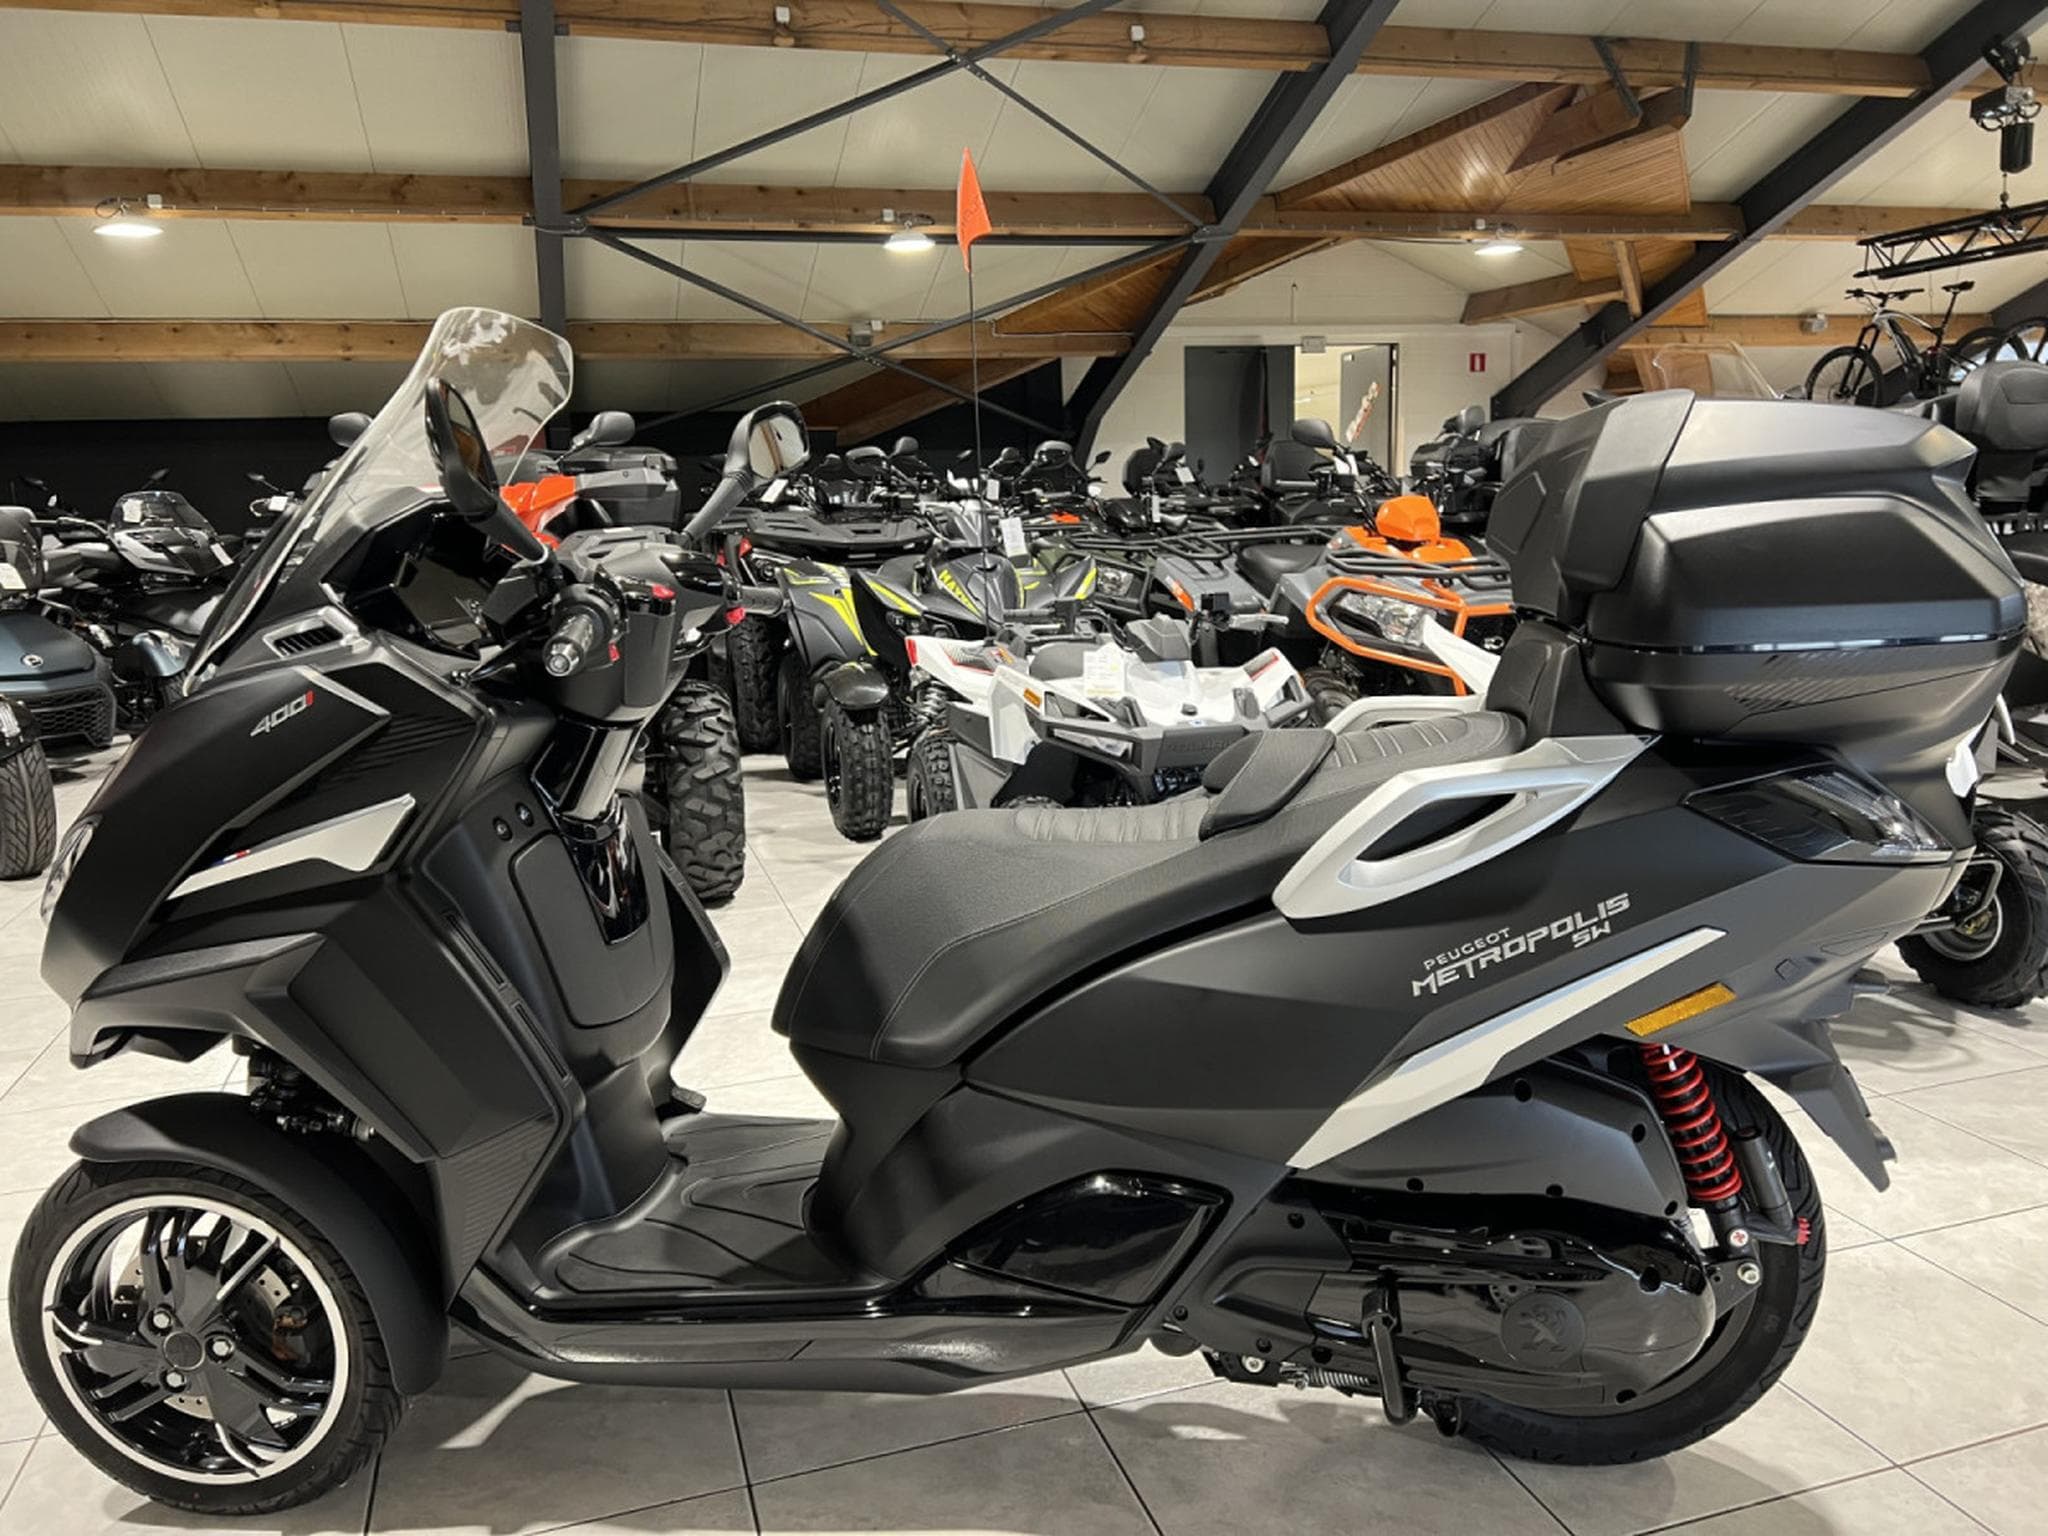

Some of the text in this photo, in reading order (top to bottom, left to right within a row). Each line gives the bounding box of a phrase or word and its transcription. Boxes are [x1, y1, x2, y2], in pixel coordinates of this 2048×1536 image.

[1411, 892, 1631, 997] METROPOLIS
[1423, 927, 1511, 970] PEUGEOT
[1571, 920, 1611, 948] SW
